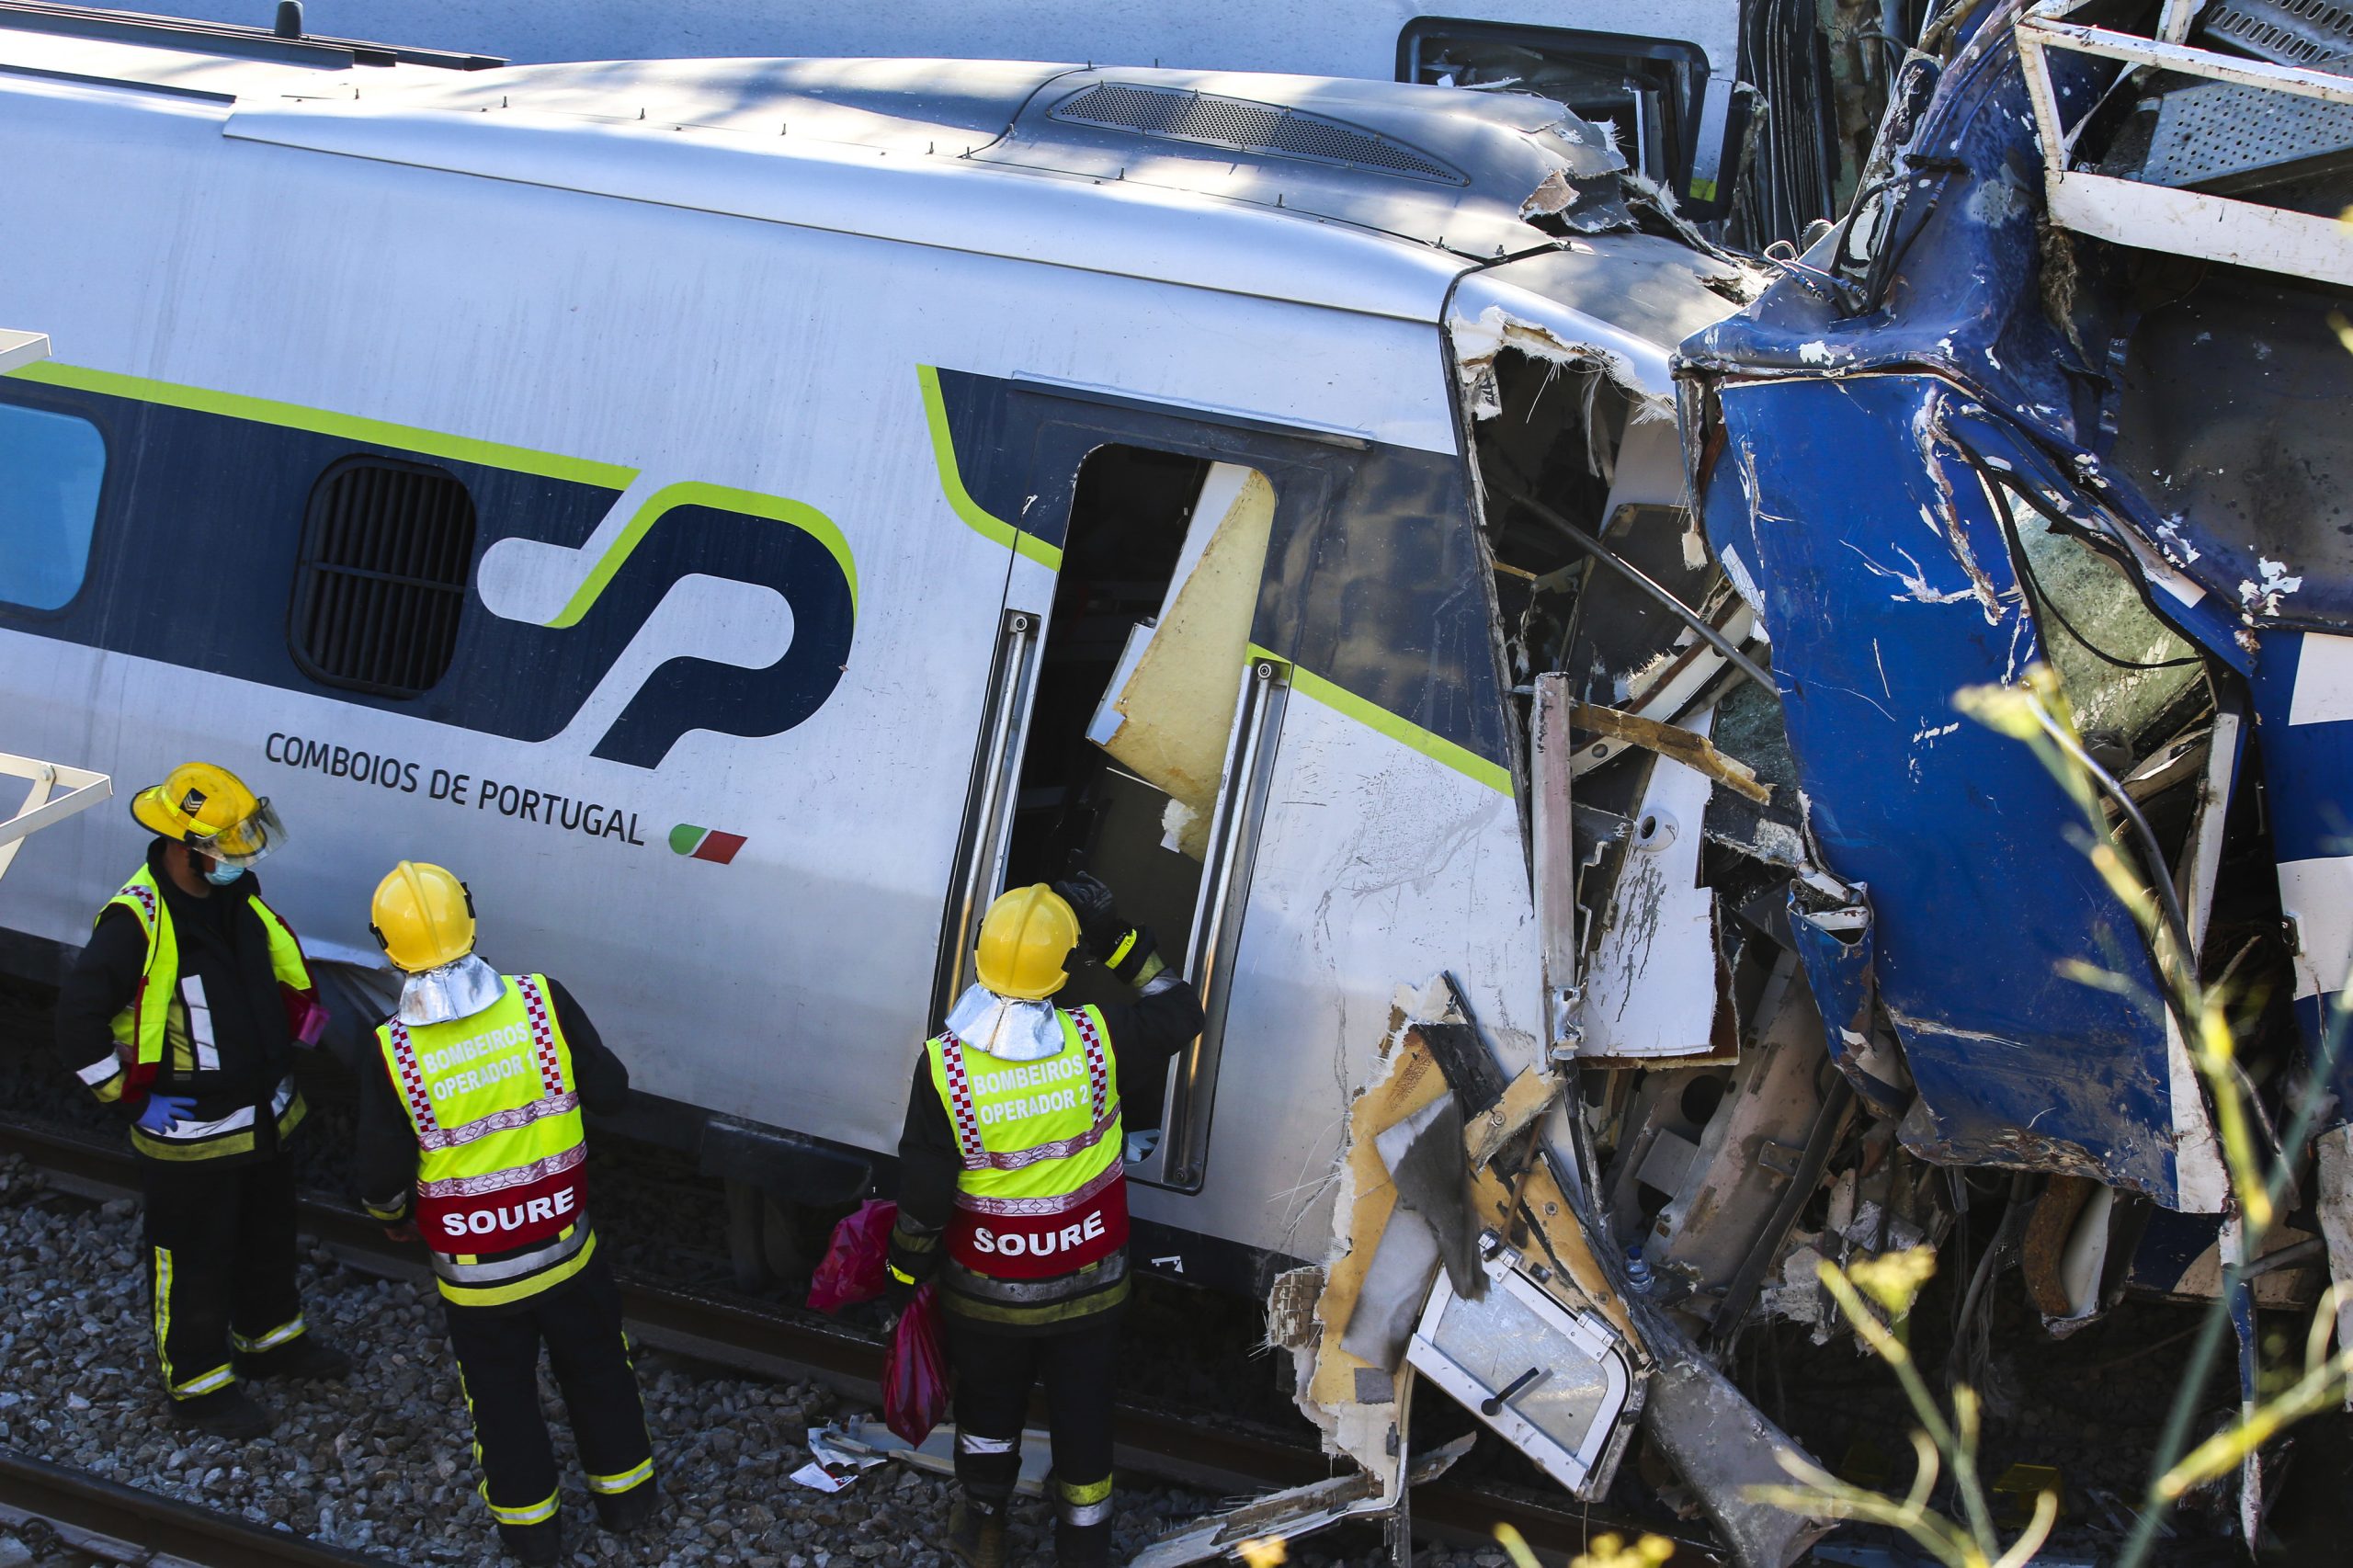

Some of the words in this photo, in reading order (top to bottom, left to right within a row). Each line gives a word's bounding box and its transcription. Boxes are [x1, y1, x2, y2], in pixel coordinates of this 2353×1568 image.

[265, 732, 421, 793] COMBOIOS
[429, 769, 471, 805] DE
[478, 779, 645, 846] PORTUGAL
[422, 1021, 529, 1074] BOMBEIROS
[433, 1057, 525, 1101] OPERADOR
[526, 1049, 537, 1071] 1
[972, 1054, 1085, 1096] BOMBEIROS
[980, 1088, 1076, 1125] OPERADOR
[1079, 1085, 1089, 1104] 2
[441, 1186, 575, 1236] SOURE
[972, 1210, 1106, 1256] SOURE
